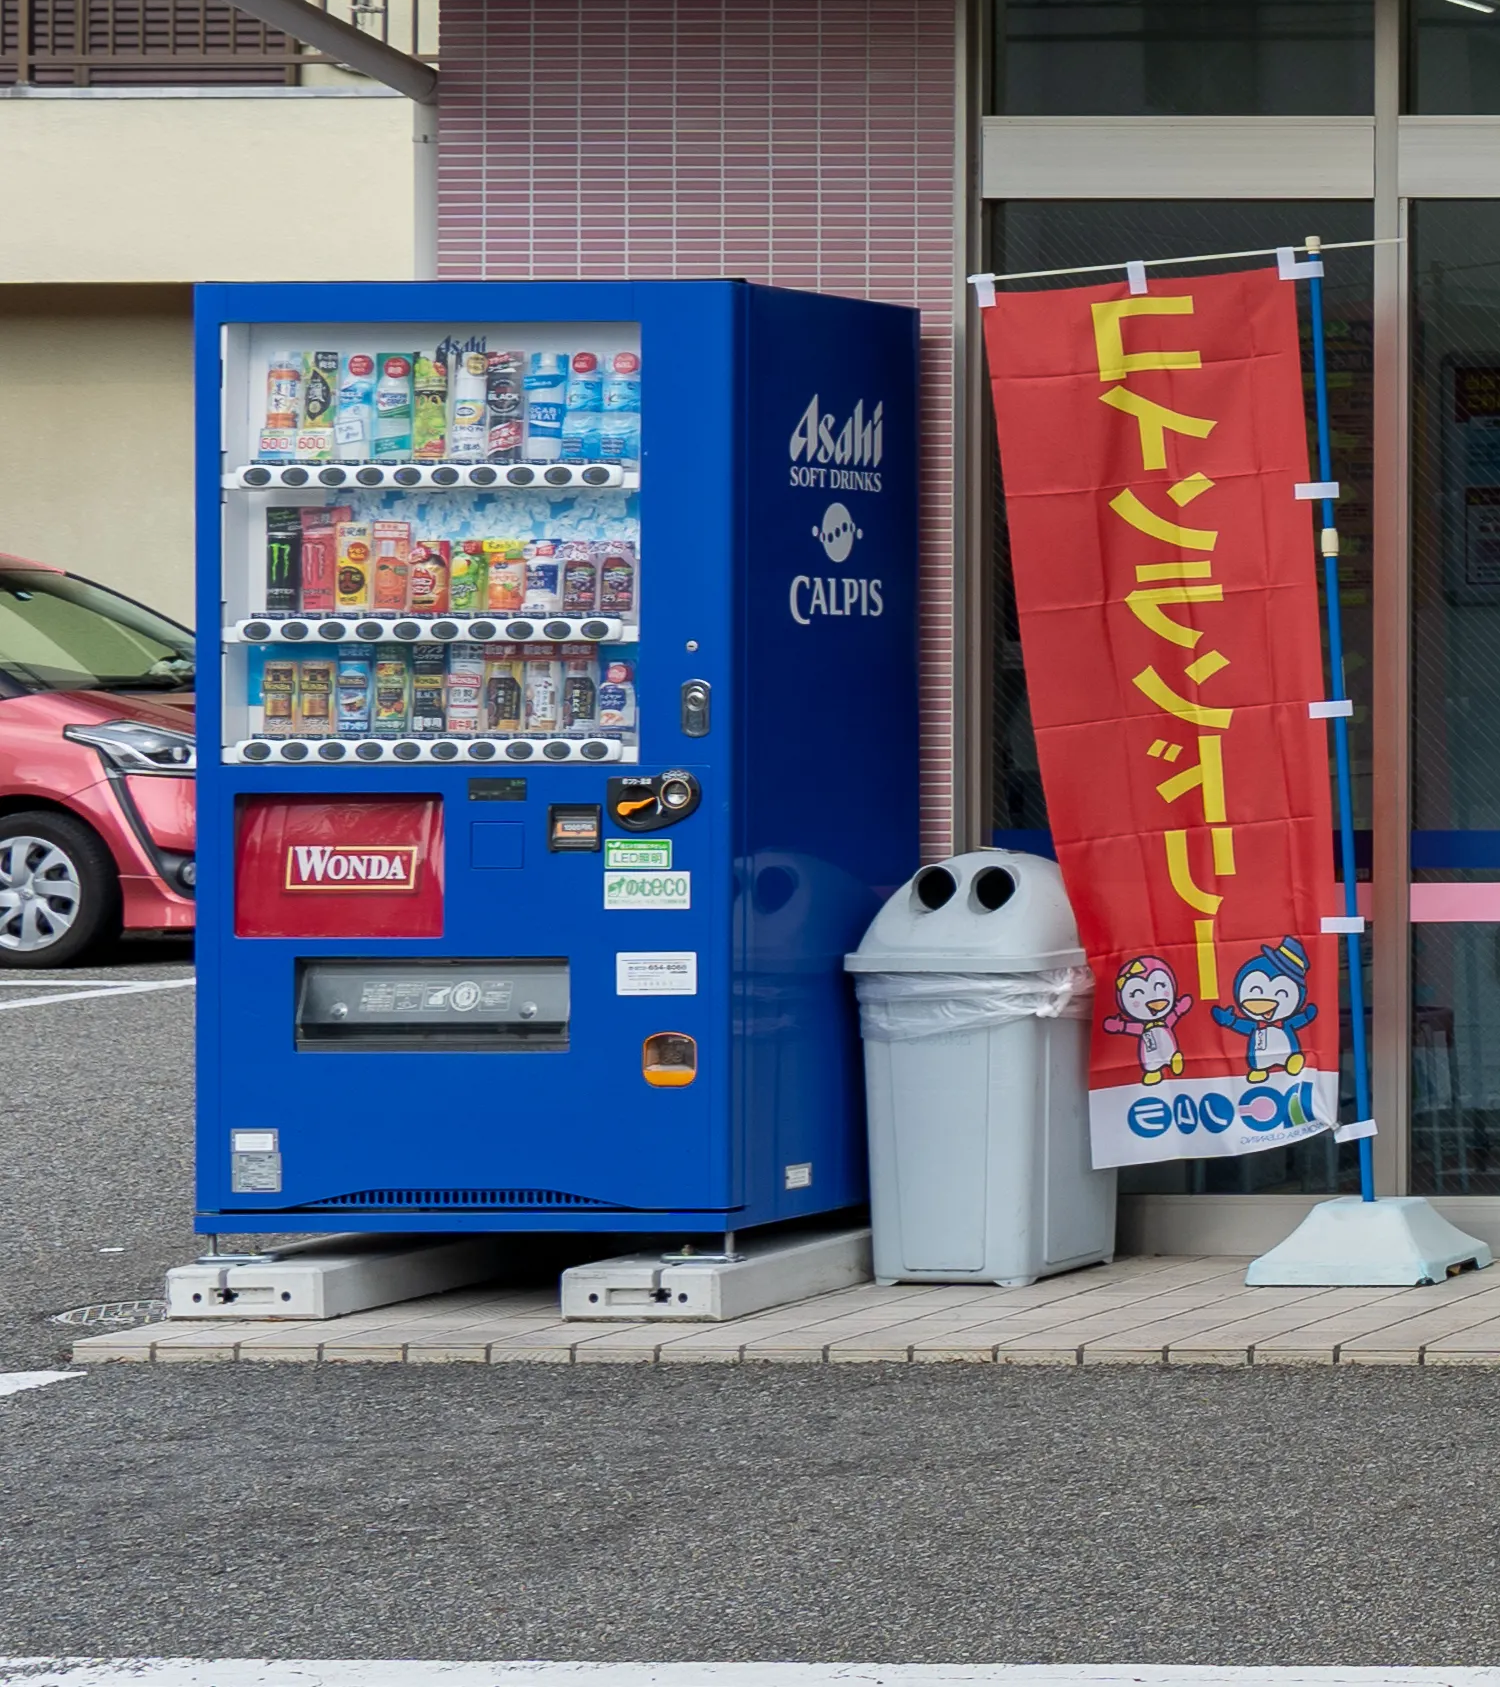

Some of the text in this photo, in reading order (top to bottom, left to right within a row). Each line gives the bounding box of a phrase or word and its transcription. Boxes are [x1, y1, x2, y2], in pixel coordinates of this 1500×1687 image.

[789, 393, 883, 468] Asahi
[789, 466, 882, 493] SOFT DRINKS
[789, 574, 884, 625] CALPIS
[294, 845, 408, 882] WONDA
[613, 852, 664, 865] LED照明
